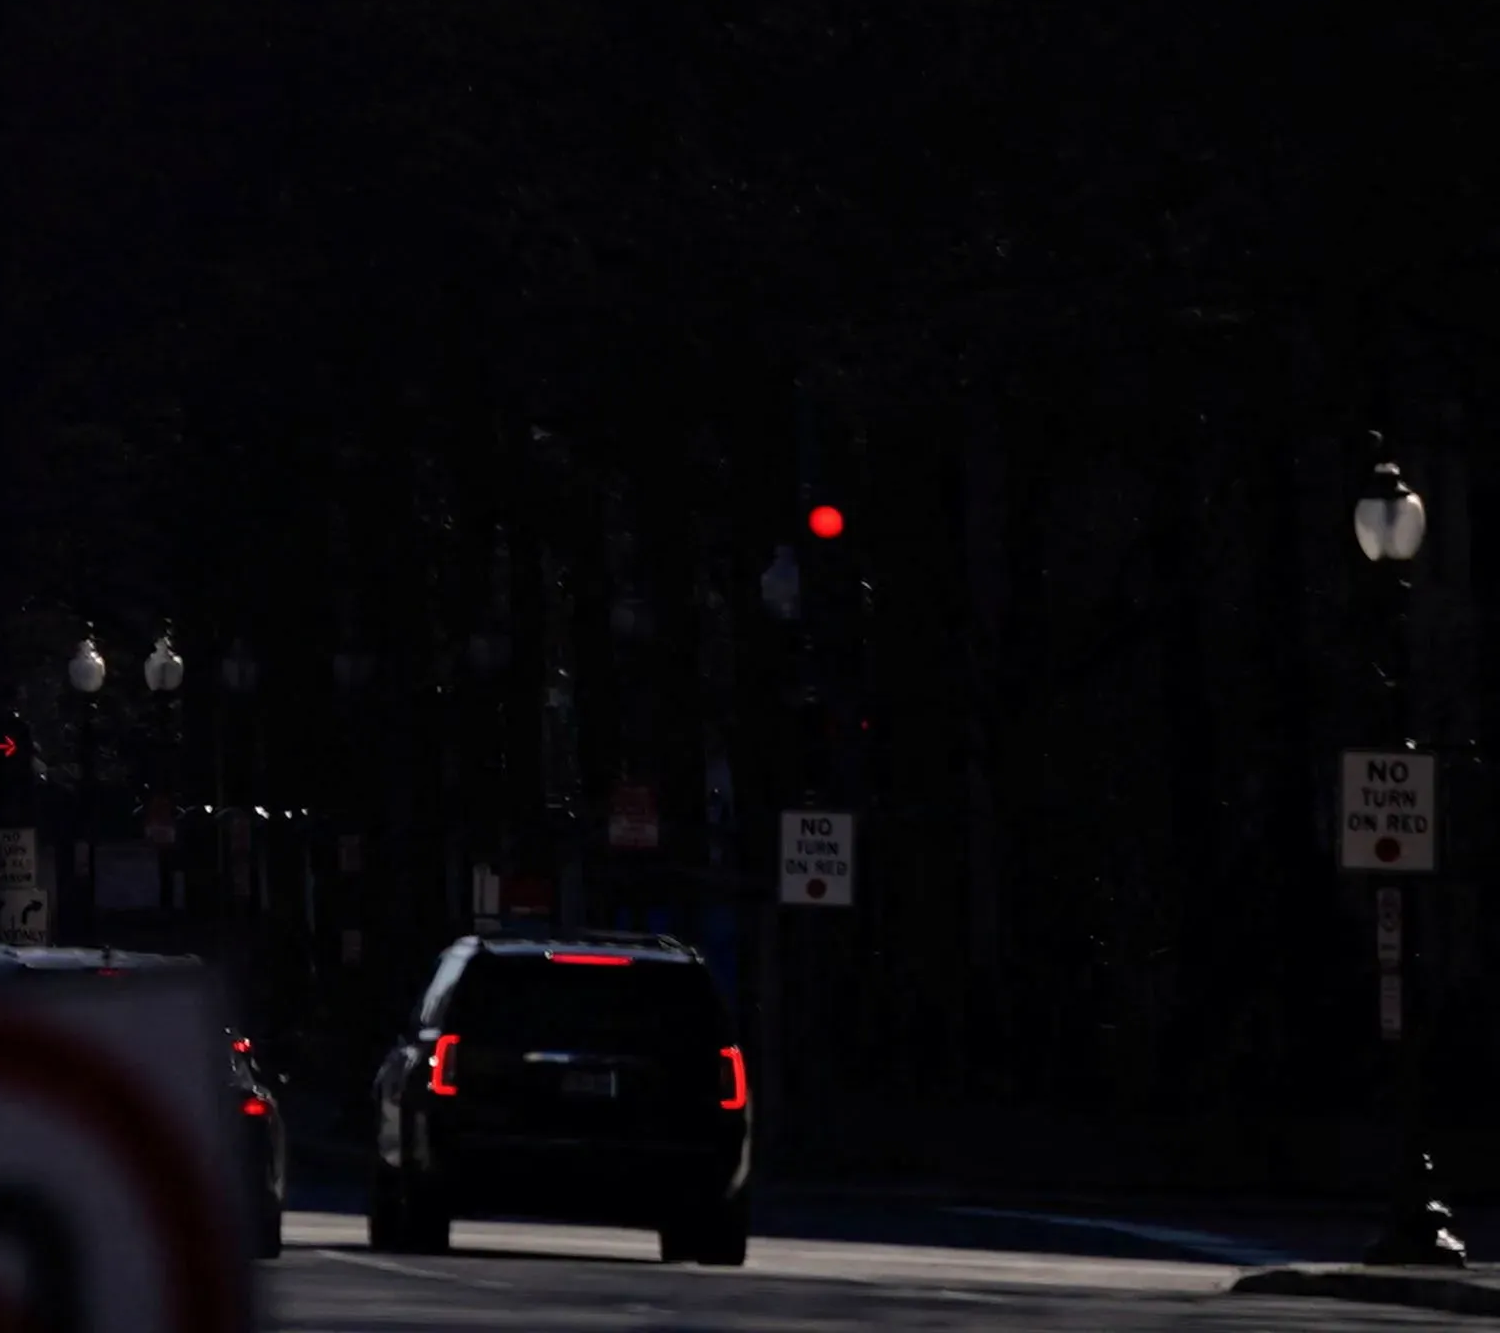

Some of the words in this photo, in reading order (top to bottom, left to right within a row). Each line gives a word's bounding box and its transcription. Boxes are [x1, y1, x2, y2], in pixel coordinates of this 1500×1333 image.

[1367, 761, 1409, 784] NO
[1362, 788, 1417, 809] TURN
[801, 818, 833, 836] NO
[1348, 815, 1378, 832] ON
[1387, 815, 1428, 833] RED
[796, 839, 839, 855] TURN
[785, 859, 808, 875] ON
[815, 860, 848, 876] RED
